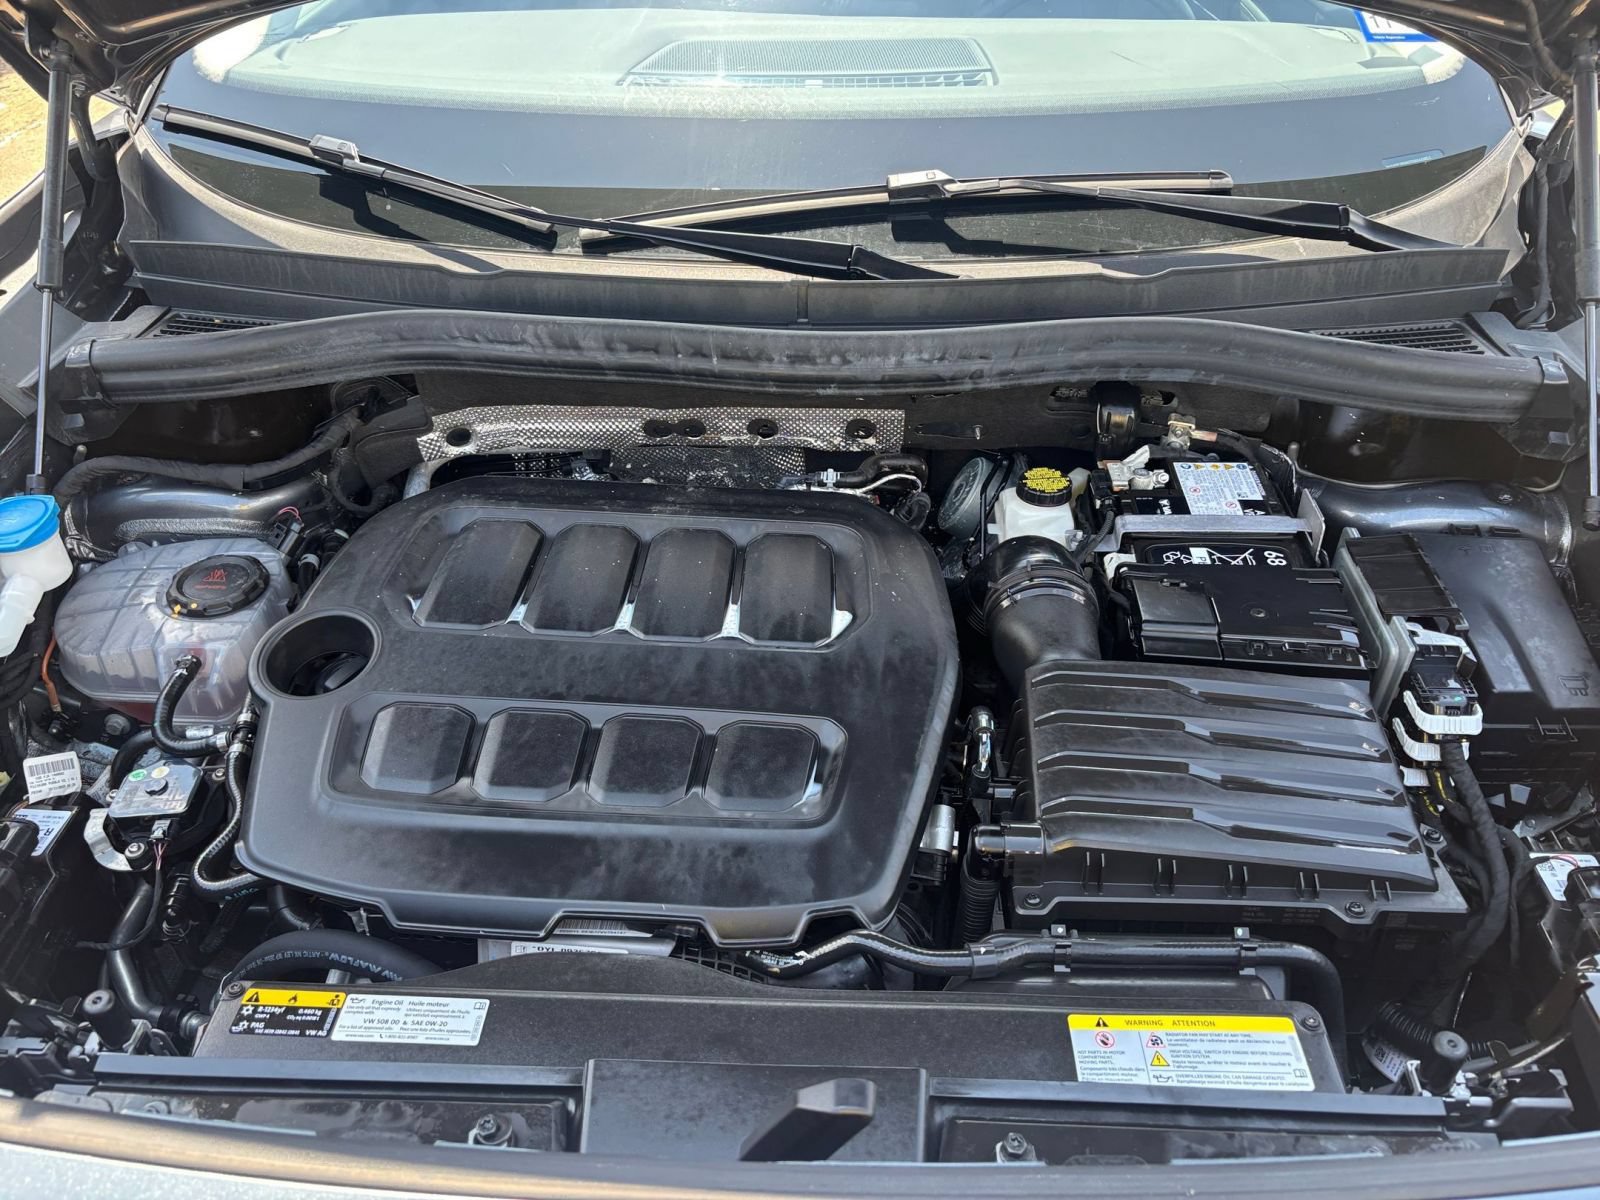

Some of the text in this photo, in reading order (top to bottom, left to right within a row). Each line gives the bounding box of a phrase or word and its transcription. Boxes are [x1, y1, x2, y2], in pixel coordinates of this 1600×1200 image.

[1264, 550, 1287, 566] 68
[328, 951, 382, 973] MAFLOW
[258, 1006, 286, 1014] R-1234yf
